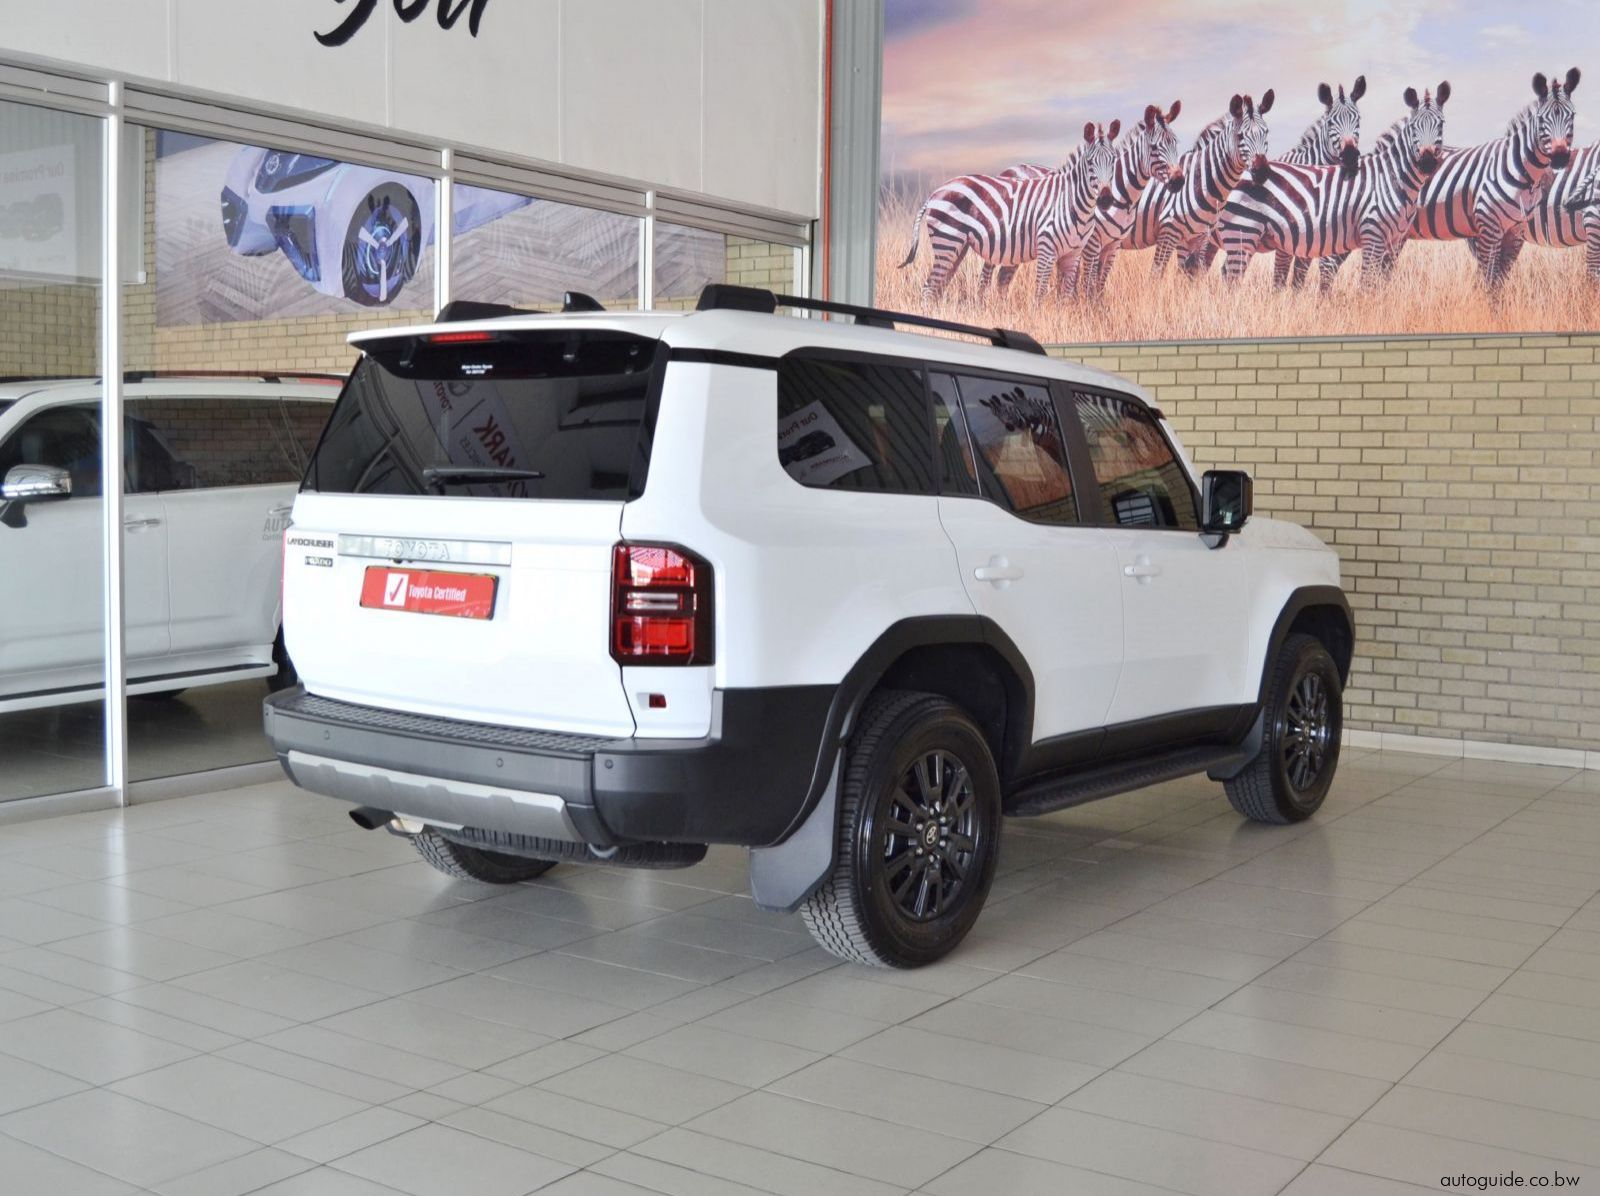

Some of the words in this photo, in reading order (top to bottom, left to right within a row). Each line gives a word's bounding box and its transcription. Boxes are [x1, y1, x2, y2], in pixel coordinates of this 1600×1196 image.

[384, 539, 450, 561] TOYOTA
[409, 584, 433, 599] Toyota
[433, 586, 467, 602] Certified
